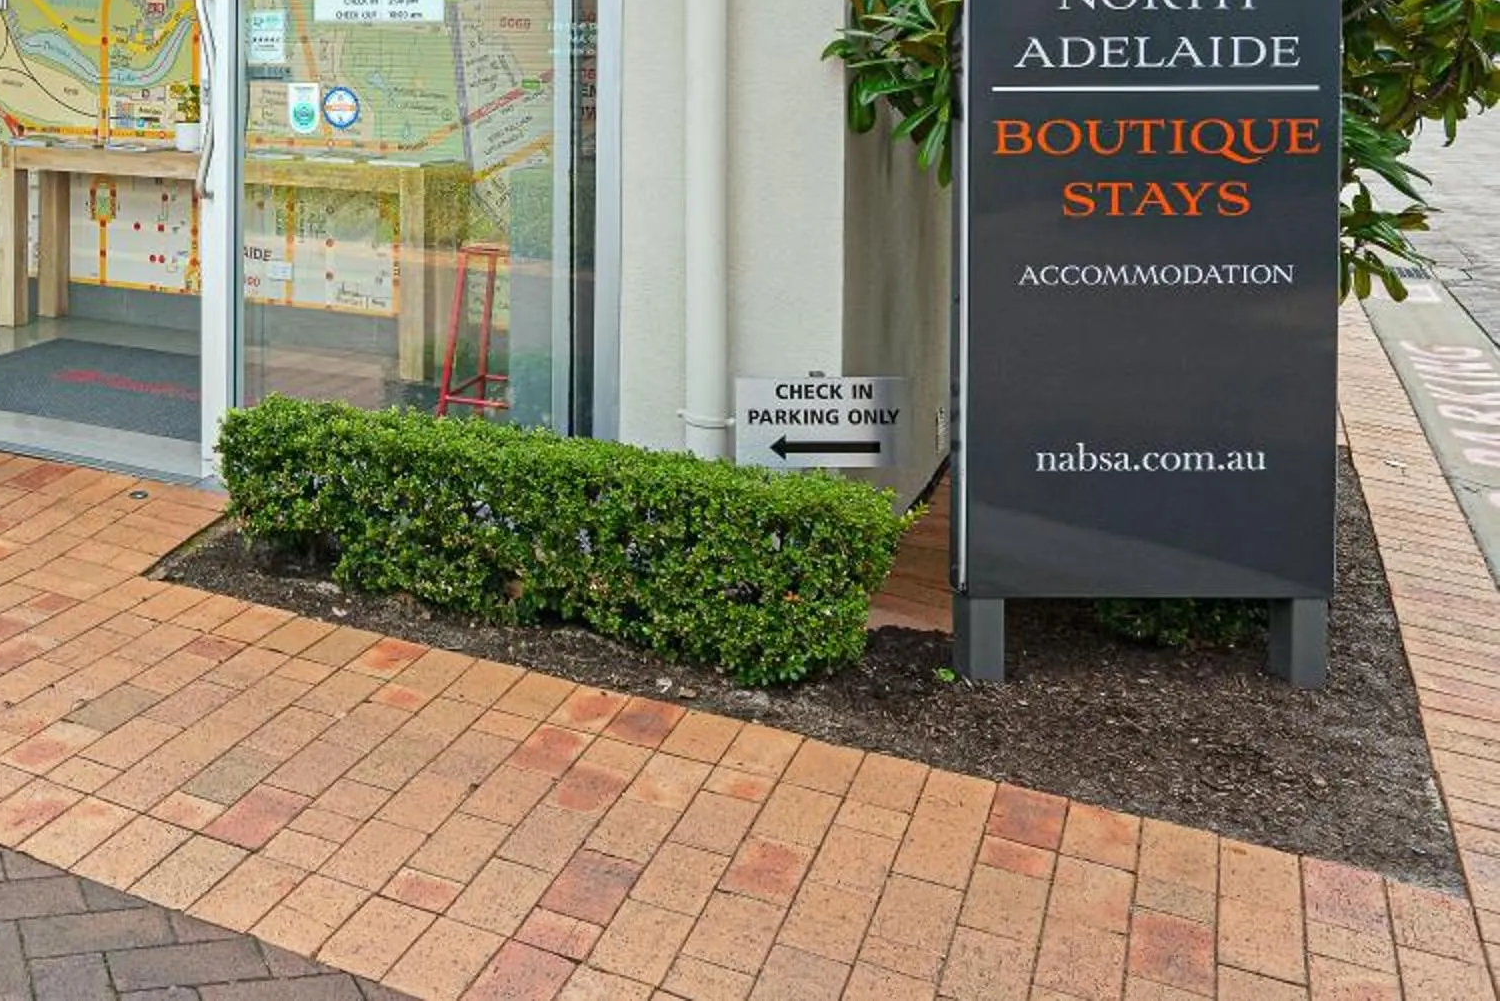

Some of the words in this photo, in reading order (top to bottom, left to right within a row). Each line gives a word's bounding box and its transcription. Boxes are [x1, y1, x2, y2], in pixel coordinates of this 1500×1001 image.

[1013, 35, 1302, 69] ADELAIDE
[992, 117, 1321, 165] BOUTIQUE
[1062, 181, 1252, 218] STAYS
[1018, 263, 1295, 287] ACCOMMODATION
[775, 383, 844, 400] CHECK
[852, 383, 873, 399] IN
[748, 408, 840, 426] PARKING
[847, 408, 900, 425] ONLY
[1035, 443, 1267, 474] nabsa.com.au
